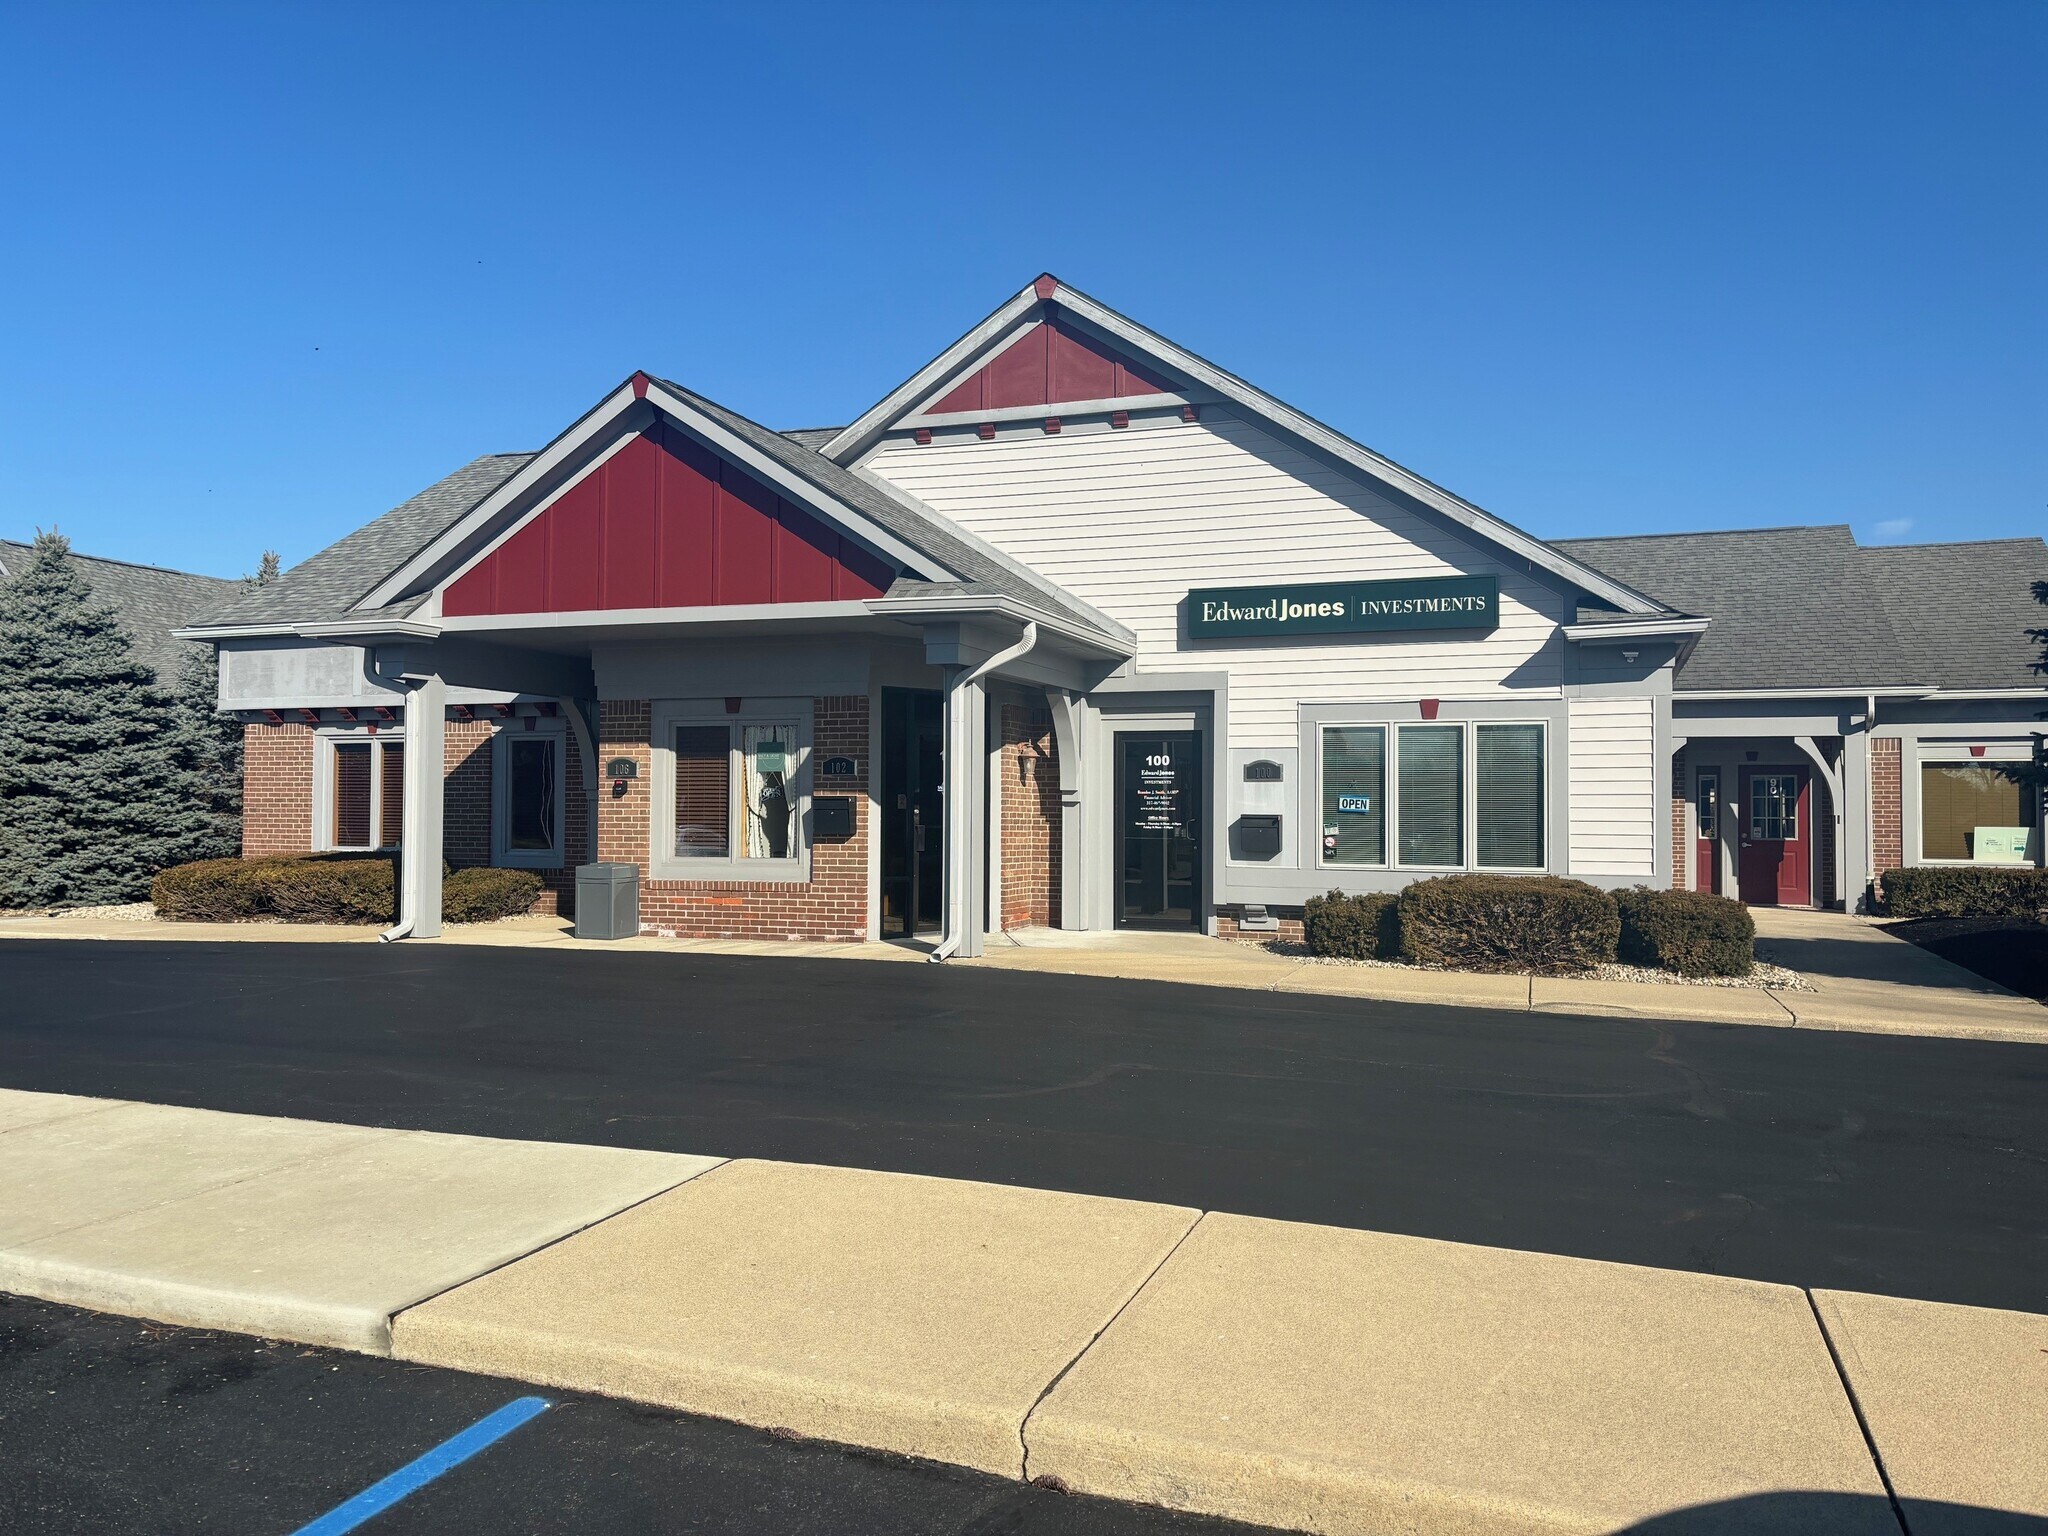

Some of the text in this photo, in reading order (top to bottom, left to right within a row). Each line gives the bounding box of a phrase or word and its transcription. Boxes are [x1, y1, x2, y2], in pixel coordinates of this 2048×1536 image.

[1361, 596, 1486, 615] INVESTMENTS
[1145, 755, 1170, 766] 100
[615, 763, 629, 775] 106
[831, 761, 846, 773] 102
[1255, 767, 1271, 779] 100
[1342, 798, 1367, 809] OPEN
